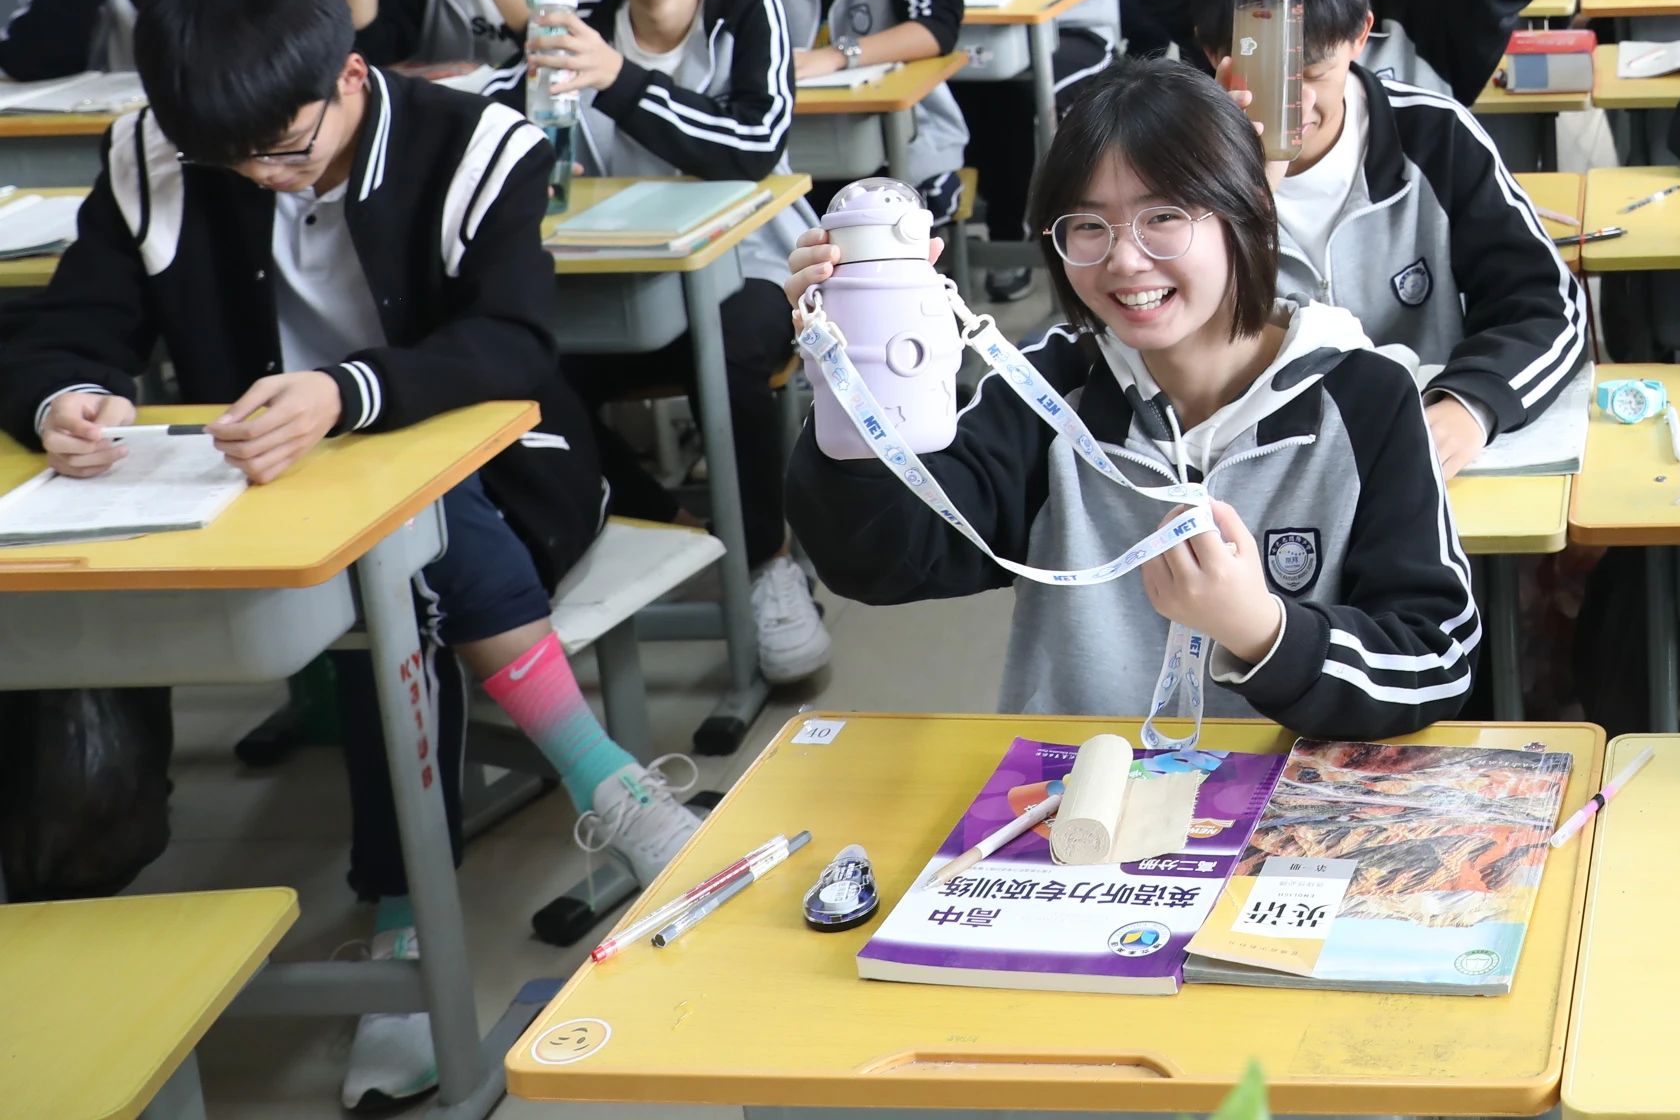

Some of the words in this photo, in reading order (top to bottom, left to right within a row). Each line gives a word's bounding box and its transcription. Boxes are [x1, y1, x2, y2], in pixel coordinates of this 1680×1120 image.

[1138, 858, 1218, 873] 高二分册
[937, 875, 1201, 909] 英语听力专项训练
[927, 905, 1002, 928] 高中
[1244, 901, 1332, 928] 英语
